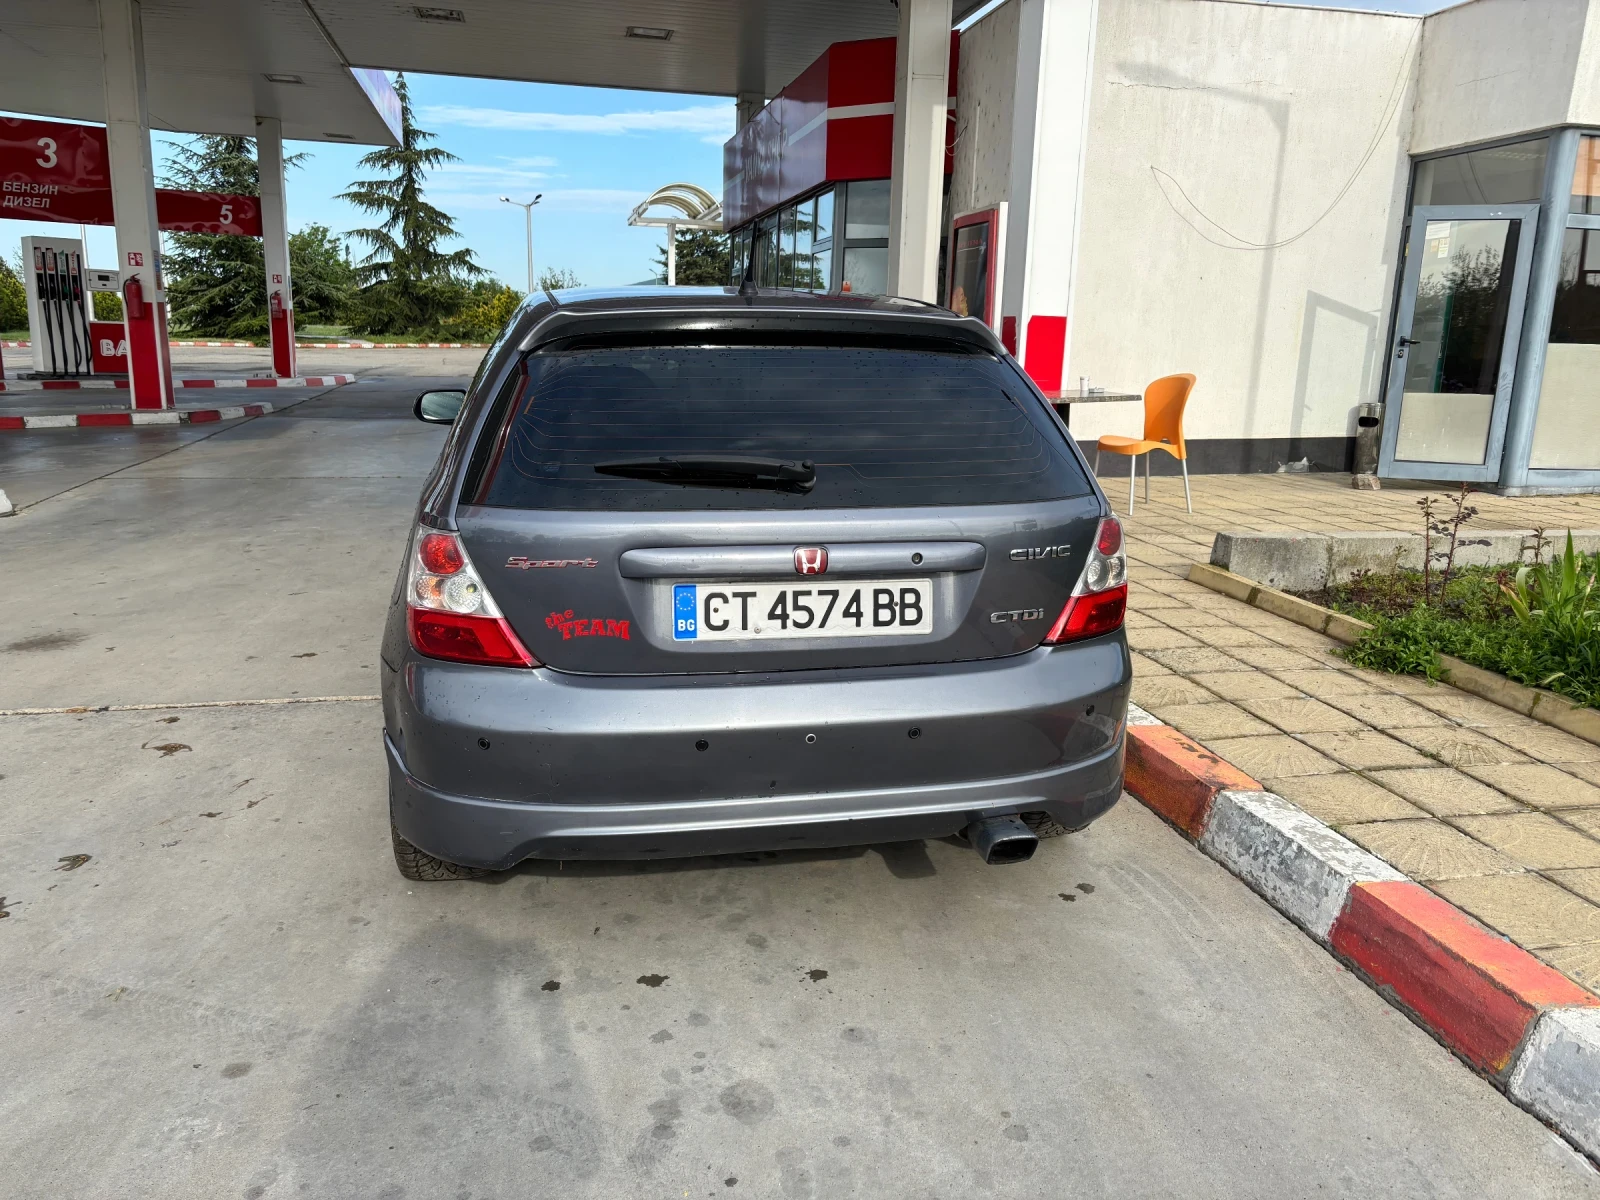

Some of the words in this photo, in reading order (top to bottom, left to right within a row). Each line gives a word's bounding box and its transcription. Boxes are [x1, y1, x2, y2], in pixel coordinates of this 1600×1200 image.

[36, 137, 58, 168] 3
[2, 181, 58, 195] БЕНЗИН
[2, 195, 51, 208] ДИЗЕЛ
[219, 204, 233, 225] 5
[1009, 545, 1071, 561] CIVIC
[504, 556, 599, 570] Sport
[544, 608, 575, 629] the
[704, 592, 757, 632] CT
[767, 588, 863, 630] 4574
[872, 587, 923, 627] BB
[558, 618, 631, 641] TEAM
[677, 619, 696, 632] BG
